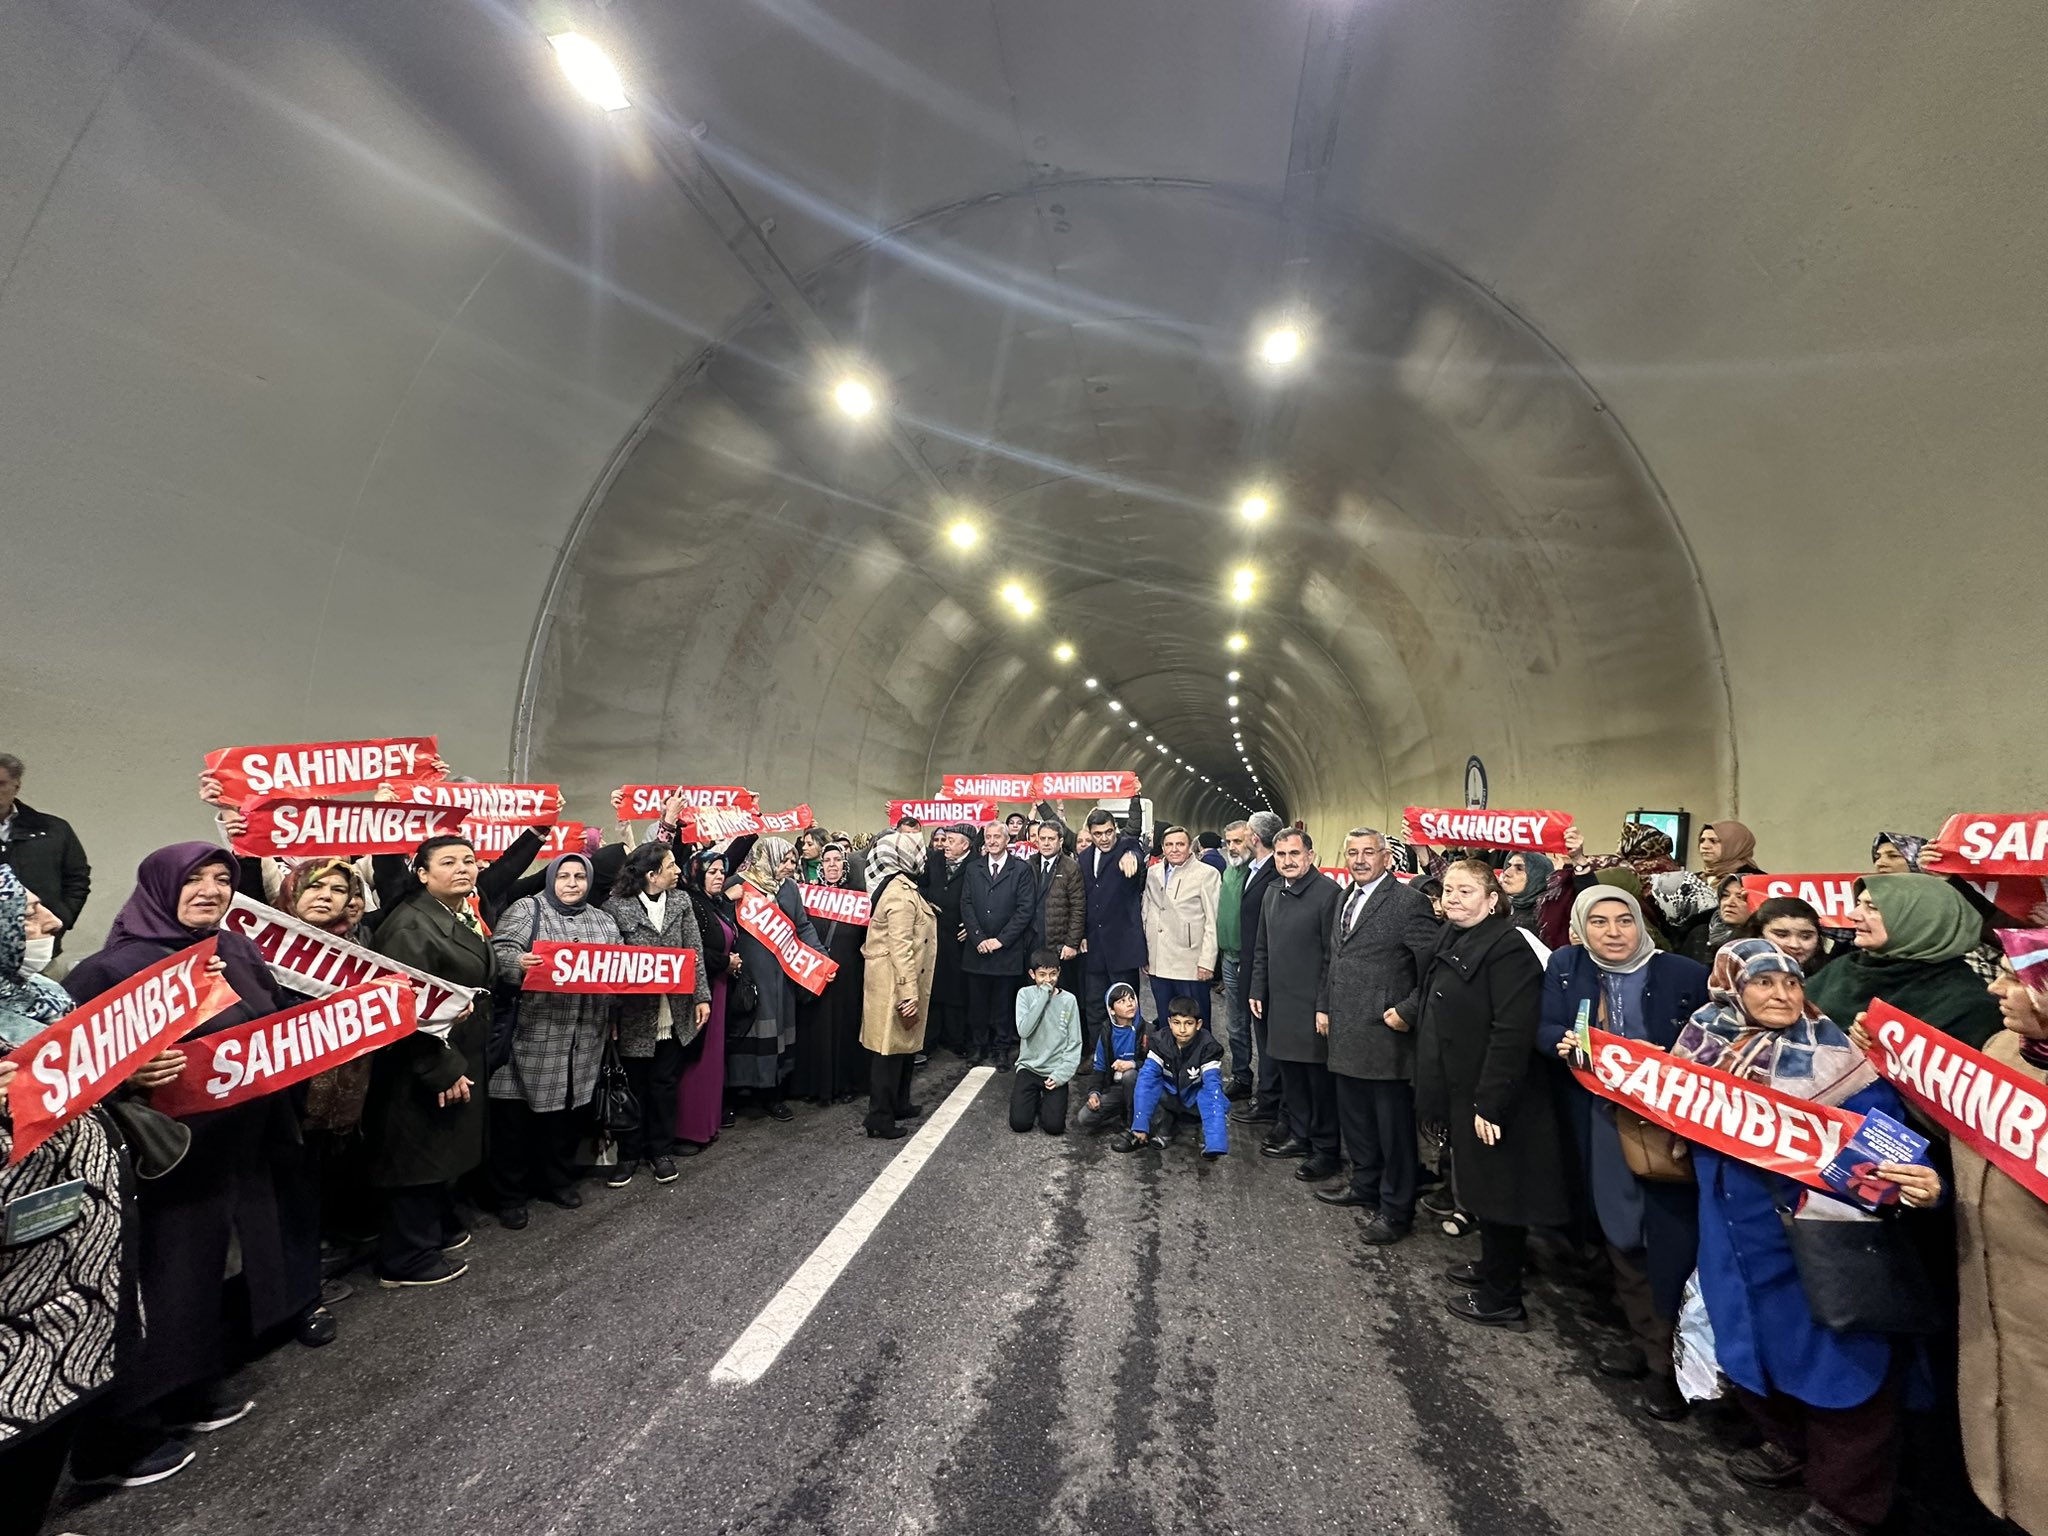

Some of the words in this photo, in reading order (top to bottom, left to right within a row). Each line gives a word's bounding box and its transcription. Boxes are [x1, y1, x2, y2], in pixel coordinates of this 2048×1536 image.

[242, 743, 419, 795] ŞAHİNBEY
[954, 777, 1031, 798] ŞAHİNBEY
[1043, 774, 1123, 795] ŞAHİNBEY
[633, 788, 739, 815] ŞANBEY
[270, 804, 447, 849] ŞAHİNBEY
[1419, 812, 1548, 846] ŞAHİNBEY
[551, 948, 686, 986] ŞAHİNBEY
[32, 954, 200, 1119] ŞAHİNBEY
[207, 984, 403, 1099] ŞAHİNBEY
[1595, 1043, 1843, 1170] ŞAHİNBEY
